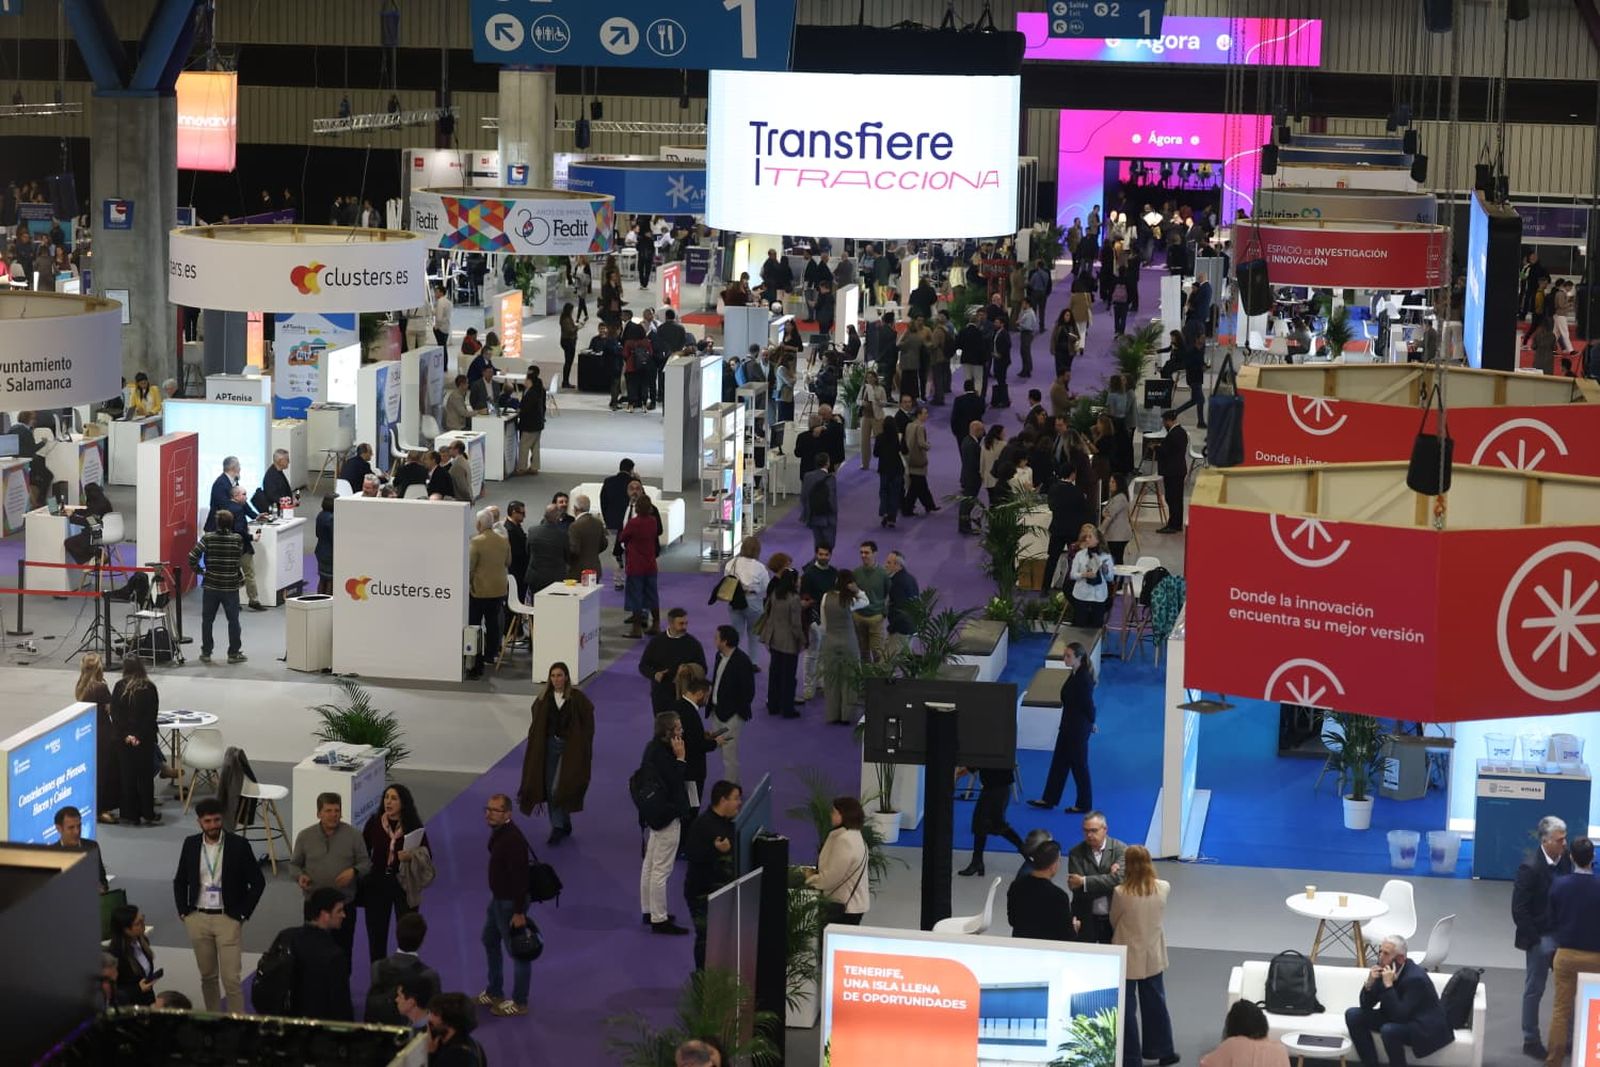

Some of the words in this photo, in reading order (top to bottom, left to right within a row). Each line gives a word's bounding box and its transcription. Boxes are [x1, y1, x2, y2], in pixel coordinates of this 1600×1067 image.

[1110, 3, 1120, 17] 2
[723, 0, 756, 59] 1
[1138, 9, 1151, 35] 1
[749, 121, 953, 161] Transfiere
[1148, 130, 1183, 147] Ágora
[553, 219, 589, 237] Fedit
[1267, 244, 1301, 255] ESPACIO
[1314, 247, 1388, 259] INVESTIGACIÓN
[1271, 255, 1328, 266] INNOVACIÓN
[325, 267, 409, 287] clusters.es
[6, 377, 72, 392] Salamanca
[1256, 450, 1290, 464] Donde
[370, 580, 451, 599] clusters.es
[1230, 587, 1276, 605] Donde
[1280, 593, 1292, 608] la
[1296, 595, 1374, 618] innovación
[1229, 607, 1300, 627] encuentra
[1304, 617, 1320, 630] su
[1324, 620, 1366, 637] mejor
[1370, 626, 1424, 643] versión
[843, 965, 904, 979] TENERIFE,
[843, 978, 869, 989] UNA
[872, 980, 898, 992] ISLA
[902, 983, 940, 995] LLENA
[843, 991, 859, 1001] DE
[862, 992, 967, 1010] OPORTUNIDADES
